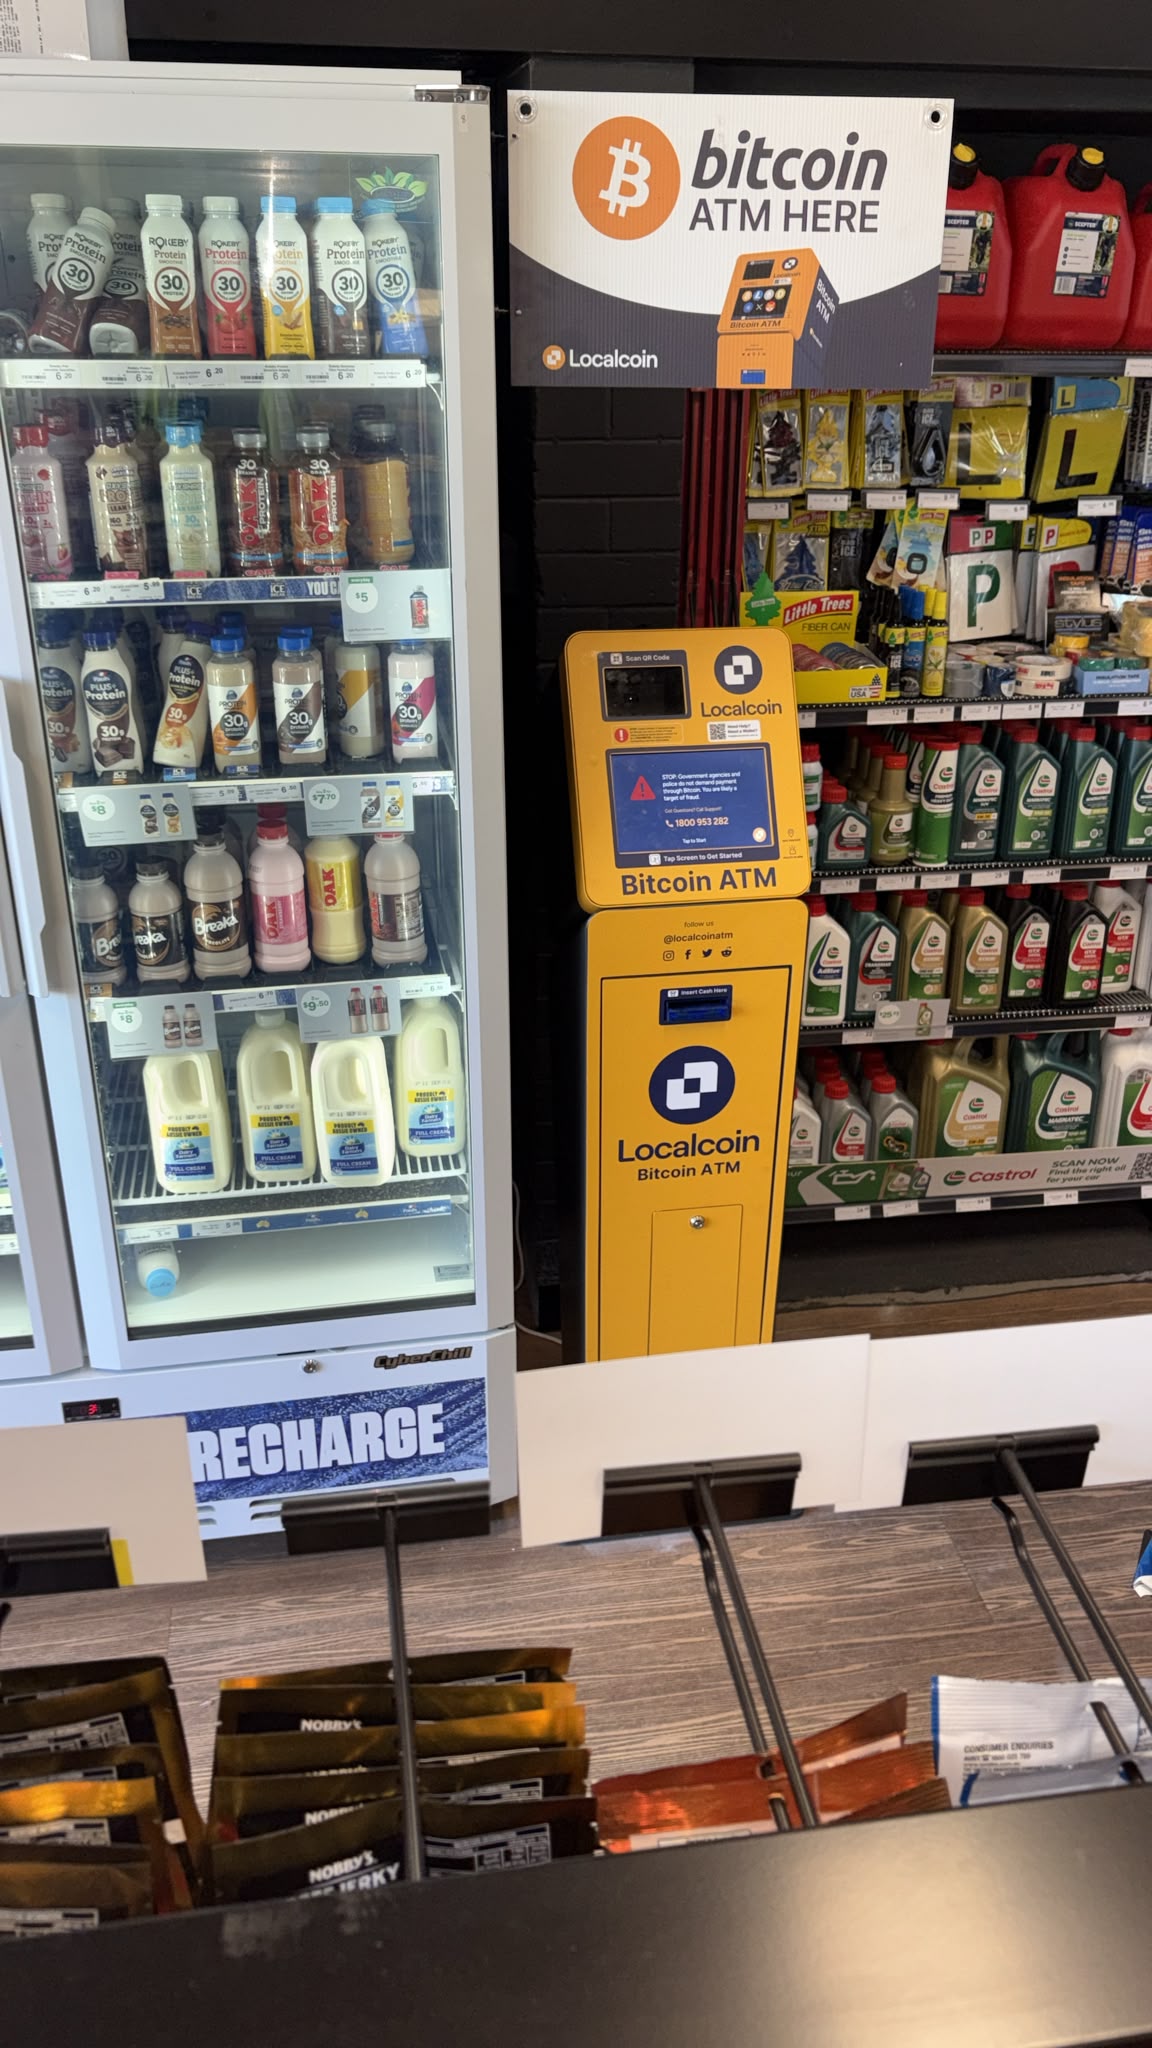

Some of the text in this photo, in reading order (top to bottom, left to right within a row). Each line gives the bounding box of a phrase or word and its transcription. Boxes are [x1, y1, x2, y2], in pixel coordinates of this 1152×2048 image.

[691, 128, 888, 191] bitcoin
[689, 198, 880, 232] ATM HERE
[149, 236, 188, 249] ROKEBY
[65, 237, 106, 264] Protein
[154, 250, 186, 260] Protein
[205, 248, 248, 260] Protein
[327, 248, 365, 260] Protein
[368, 245, 407, 260] Protein
[66, 263, 89, 283] 30
[383, 271, 403, 288] 30
[218, 276, 240, 291] 30
[276, 276, 296, 291] 30
[339, 276, 359, 291] 30
[815, 278, 836, 314] Bitcoin
[816, 299, 831, 324] ATM
[730, 321, 759, 329] Bitcoin
[569, 349, 658, 368] Localcoin
[989, 384, 1003, 399] P
[1060, 389, 1071, 406] L
[956, 422, 1002, 485] L
[1055, 429, 1098, 490] L
[238, 459, 256, 470] 30
[310, 459, 329, 470] 30
[239, 477, 260, 547] OAK
[312, 478, 334, 547] OAK
[972, 527, 994, 545] P P
[1045, 529, 1056, 544] P
[840, 545, 856, 557] ICE
[356, 592, 369, 602] $5
[967, 564, 1001, 628] P
[784, 597, 852, 624] Little Trees
[801, 622, 851, 632] FIBER CAN
[169, 672, 201, 687] Protein
[84, 689, 126, 701] Protein
[700, 699, 782, 718] Localcoin
[675, 816, 729, 827] 1800 953 282
[322, 867, 337, 908] OAK
[621, 867, 777, 896] Bitcoin ATM
[194, 914, 239, 936] Breaka
[266, 902, 280, 939] OAK
[663, 931, 734, 945] @localcoinatm
[963, 1113, 988, 1121] Castrol
[1055, 1106, 1079, 1114] Castrol
[1048, 1116, 1085, 1124] MAGNATEC
[618, 1129, 760, 1162] Localcoin
[1051, 1157, 1120, 1168] SCAN NOW
[1072, 1166, 1088, 1174] the
[1089, 1166, 1112, 1175] right
[1114, 1164, 1127, 1172] oil
[637, 1161, 741, 1181] Bitcoin ATM
[968, 1168, 1038, 1183] Castrol
[1046, 1176, 1060, 1184] for
[1060, 1175, 1084, 1184] your
[373, 1345, 473, 1370] CyberChill
[186, 1403, 446, 1482] RECHARGE
[964, 1741, 1054, 1754] CONSUMER ENQUIRIES
